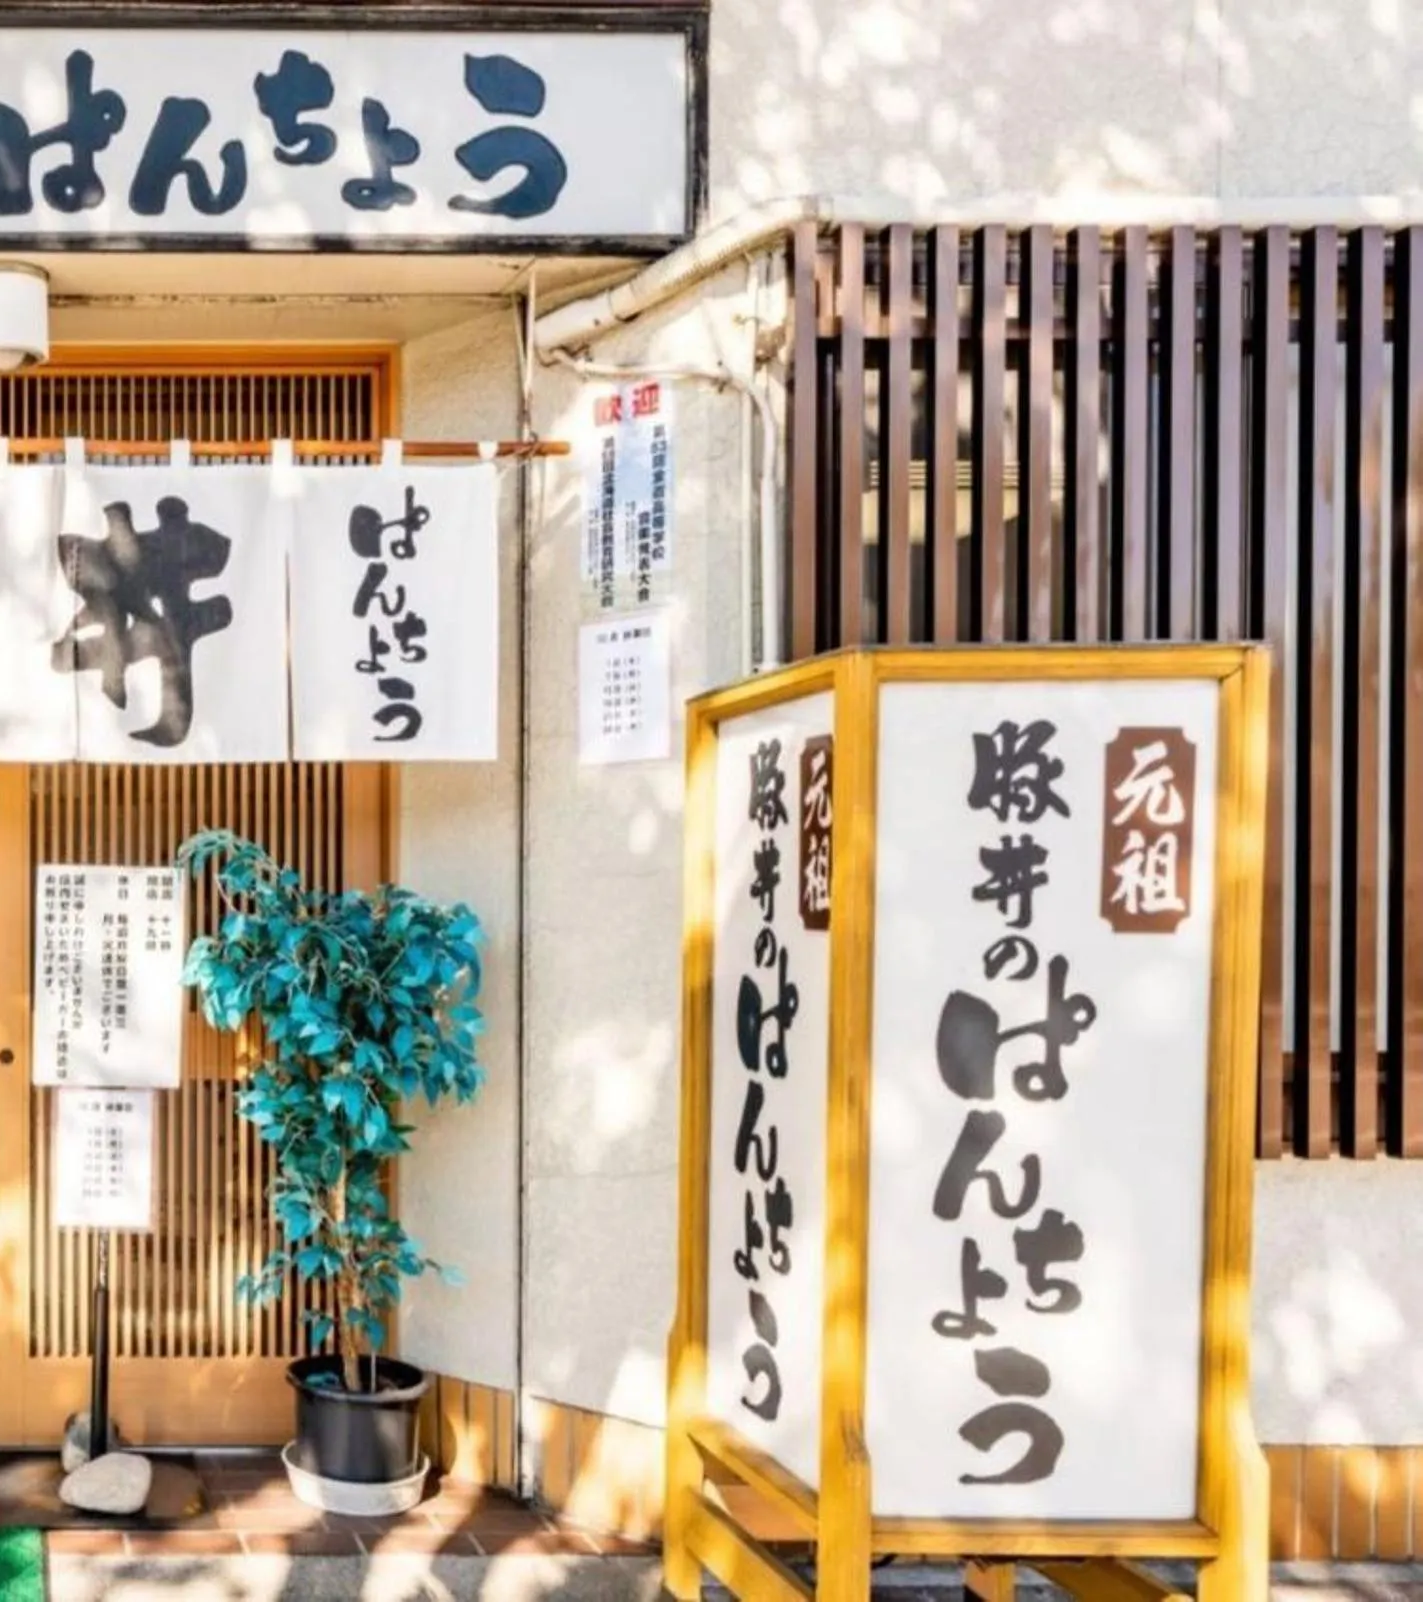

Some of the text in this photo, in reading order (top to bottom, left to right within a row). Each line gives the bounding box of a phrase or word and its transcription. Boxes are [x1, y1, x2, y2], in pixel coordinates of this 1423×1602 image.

[350, 486, 430, 742] ぱんちょう
[804, 750, 833, 912] 元祖
[1110, 740, 1185, 915] 元祖
